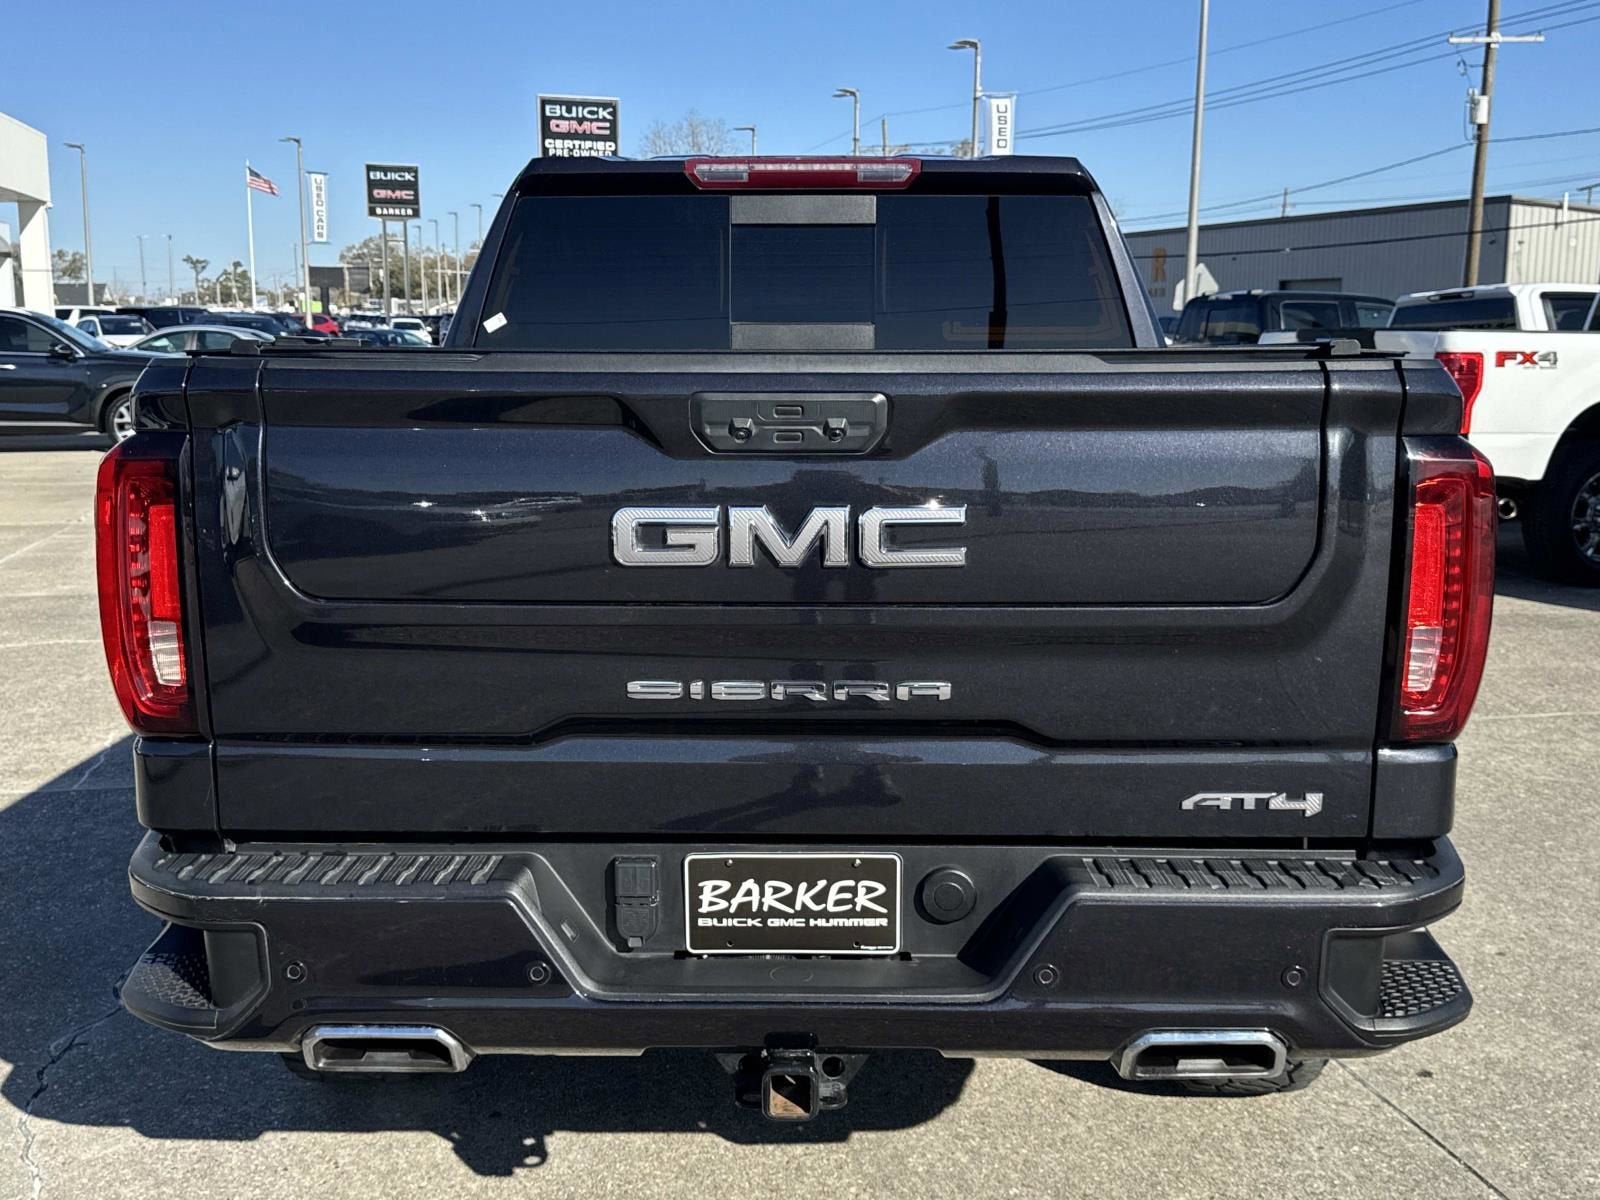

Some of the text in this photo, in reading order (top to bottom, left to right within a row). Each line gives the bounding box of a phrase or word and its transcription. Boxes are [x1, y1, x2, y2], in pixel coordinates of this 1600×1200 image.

[545, 104, 614, 120] BUICK
[550, 119, 611, 135] GMC
[996, 104, 1008, 149] USED
[544, 138, 617, 151] CERTIFIED
[548, 148, 613, 157] PRE-OWNED
[369, 171, 416, 181] BUICK
[373, 189, 415, 199] GMC
[315, 177, 325, 239] USED CARS
[375, 207, 414, 216] BARKER
[1495, 351, 1558, 368] FX4
[612, 504, 968, 568] GMC
[626, 680, 952, 701] SIERRA
[1181, 792, 1324, 818] AT4
[697, 878, 889, 914] BARKER
[697, 918, 889, 927] BUICK GMC HUMMER
